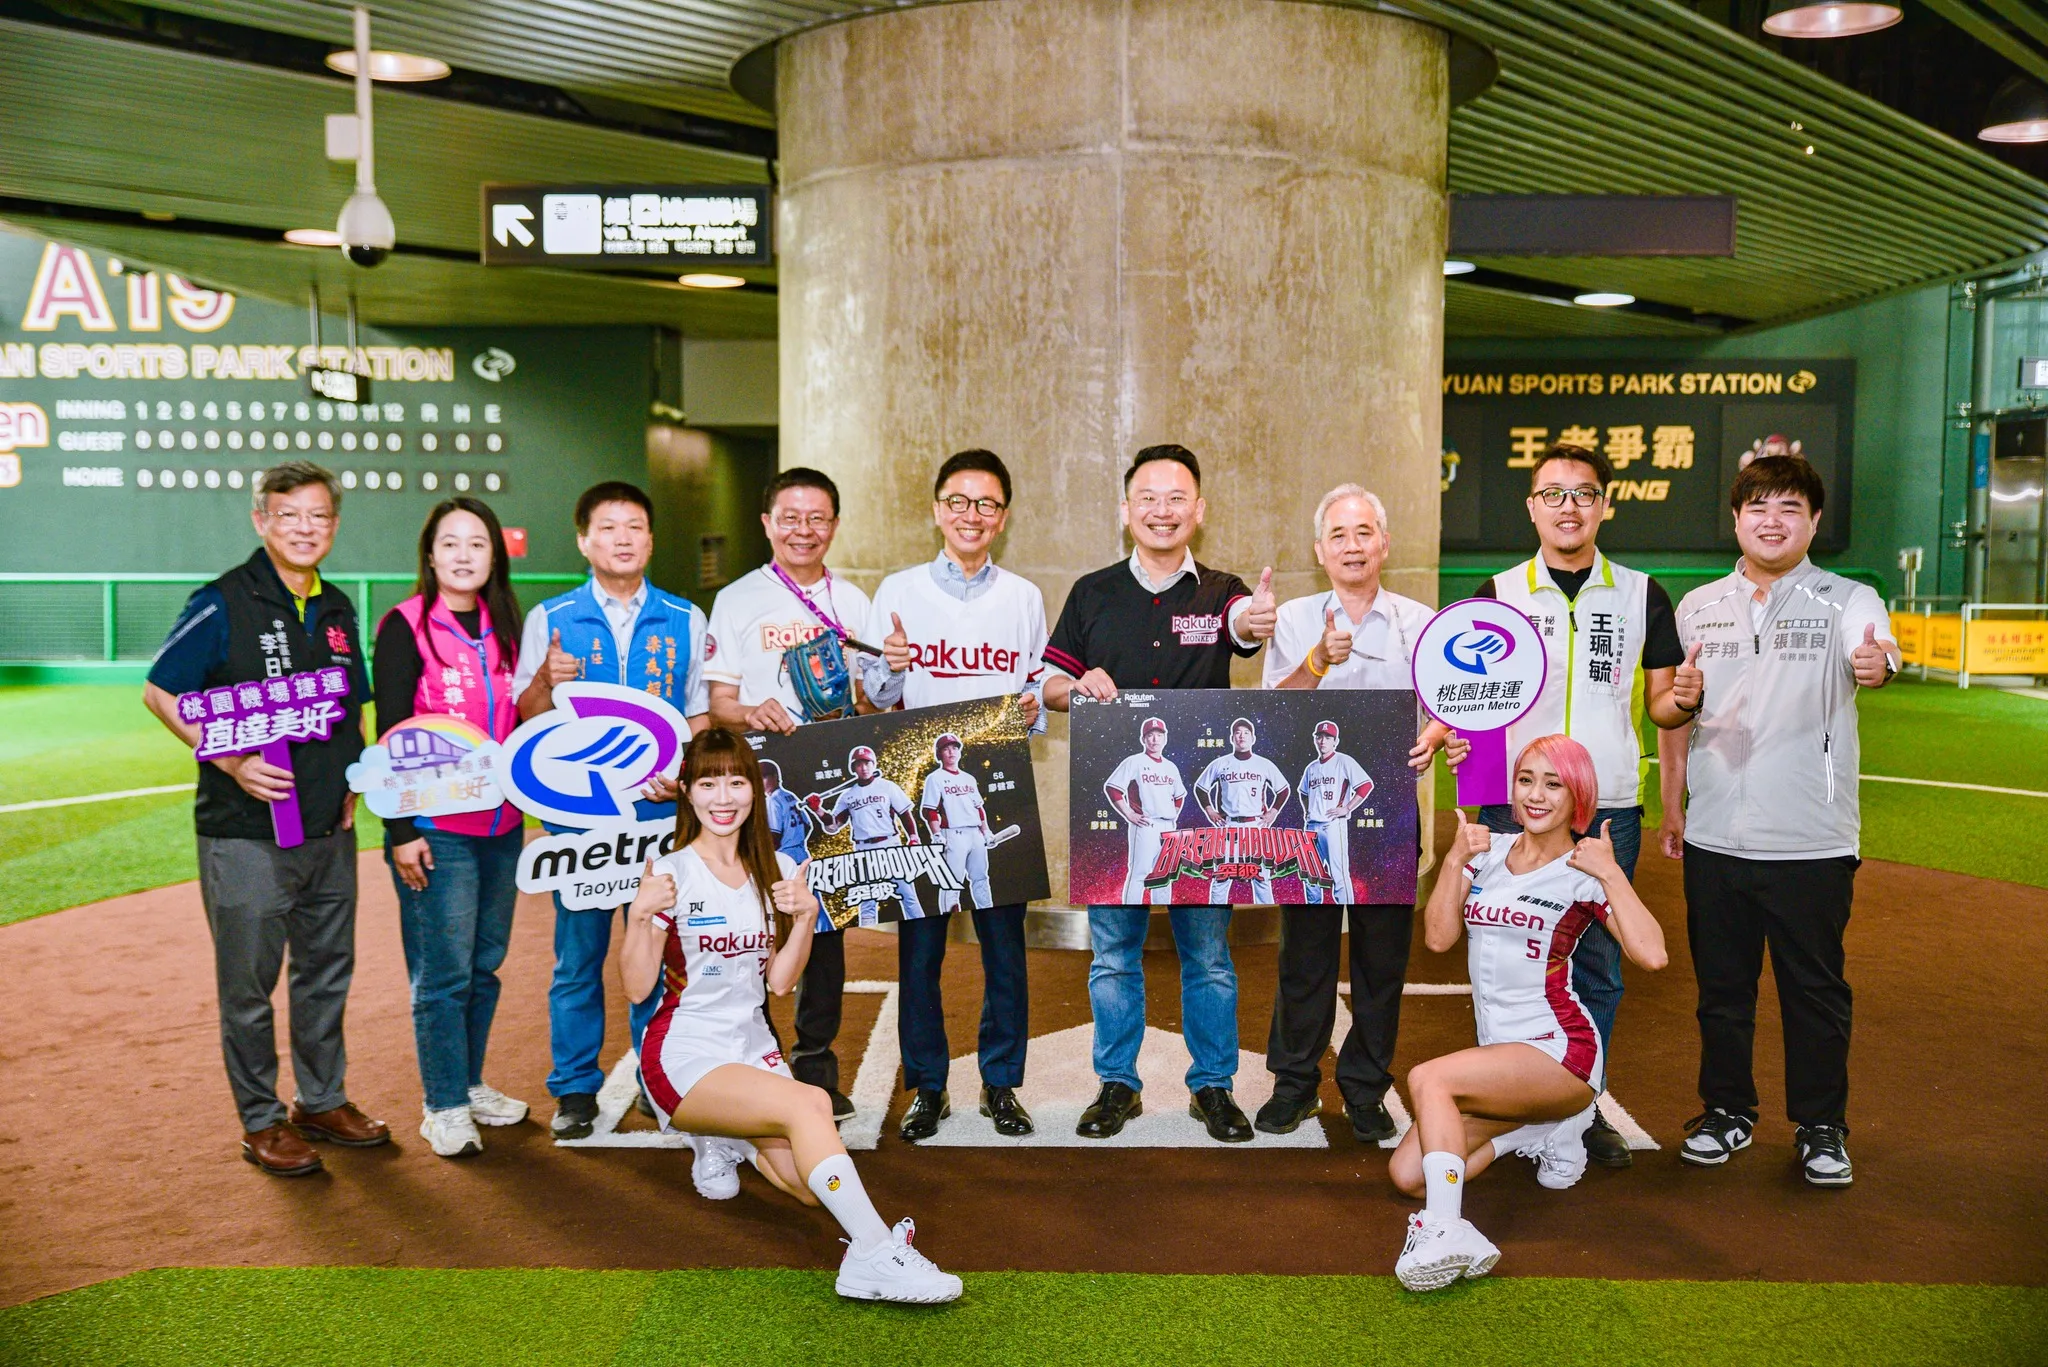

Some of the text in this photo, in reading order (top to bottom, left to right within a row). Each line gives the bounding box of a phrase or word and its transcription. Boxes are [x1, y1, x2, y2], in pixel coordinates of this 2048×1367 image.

[39, 343, 188, 379] SPORTS
[191, 344, 297, 380] PARK
[298, 346, 454, 382] STATION
[1508, 373, 1603, 395] SPORTS
[1610, 373, 1673, 395] PARK
[1680, 372, 1782, 395] STATION
[135, 400, 148, 420] 1
[156, 400, 173, 420] 2
[179, 400, 196, 420] 3
[202, 400, 219, 421] 4
[226, 400, 242, 421] 5
[249, 401, 265, 421] 6
[272, 401, 288, 421] 7
[294, 401, 310, 421] 8
[317, 402, 333, 421] 9
[382, 403, 404, 423] 12
[420, 403, 438, 423] R
[484, 403, 501, 424] E
[1588, 613, 1614, 684] 王珮毓
[1773, 632, 1827, 650] 張肇良
[259, 632, 283, 677] 李日
[182, 671, 346, 720] 桃園機場捷運
[1124, 693, 1154, 702] Rakuten
[1436, 680, 1524, 703] 桃園捷運
[1436, 701, 1521, 714] Taoyuan Metro
[198, 700, 342, 757] 直達美好
[822, 760, 829, 768] 5
[993, 772, 1004, 780] 58
[1142, 773, 1175, 785] Rakute
[1220, 771, 1262, 783] Rakuten
[1250, 787, 1257, 797] 5
[1323, 791, 1334, 801] 98
[877, 809, 883, 819] 5
[1097, 810, 1108, 818] 58
[1364, 808, 1374, 816] 98
[1211, 863, 1265, 881] 突破
[573, 877, 641, 898] Taoyua
[843, 881, 902, 906] 突破
[1463, 901, 1545, 931] akuten
[699, 931, 775, 953] Rakute
[1526, 939, 1542, 960] 5
[892, 1255, 905, 1267] FILA
